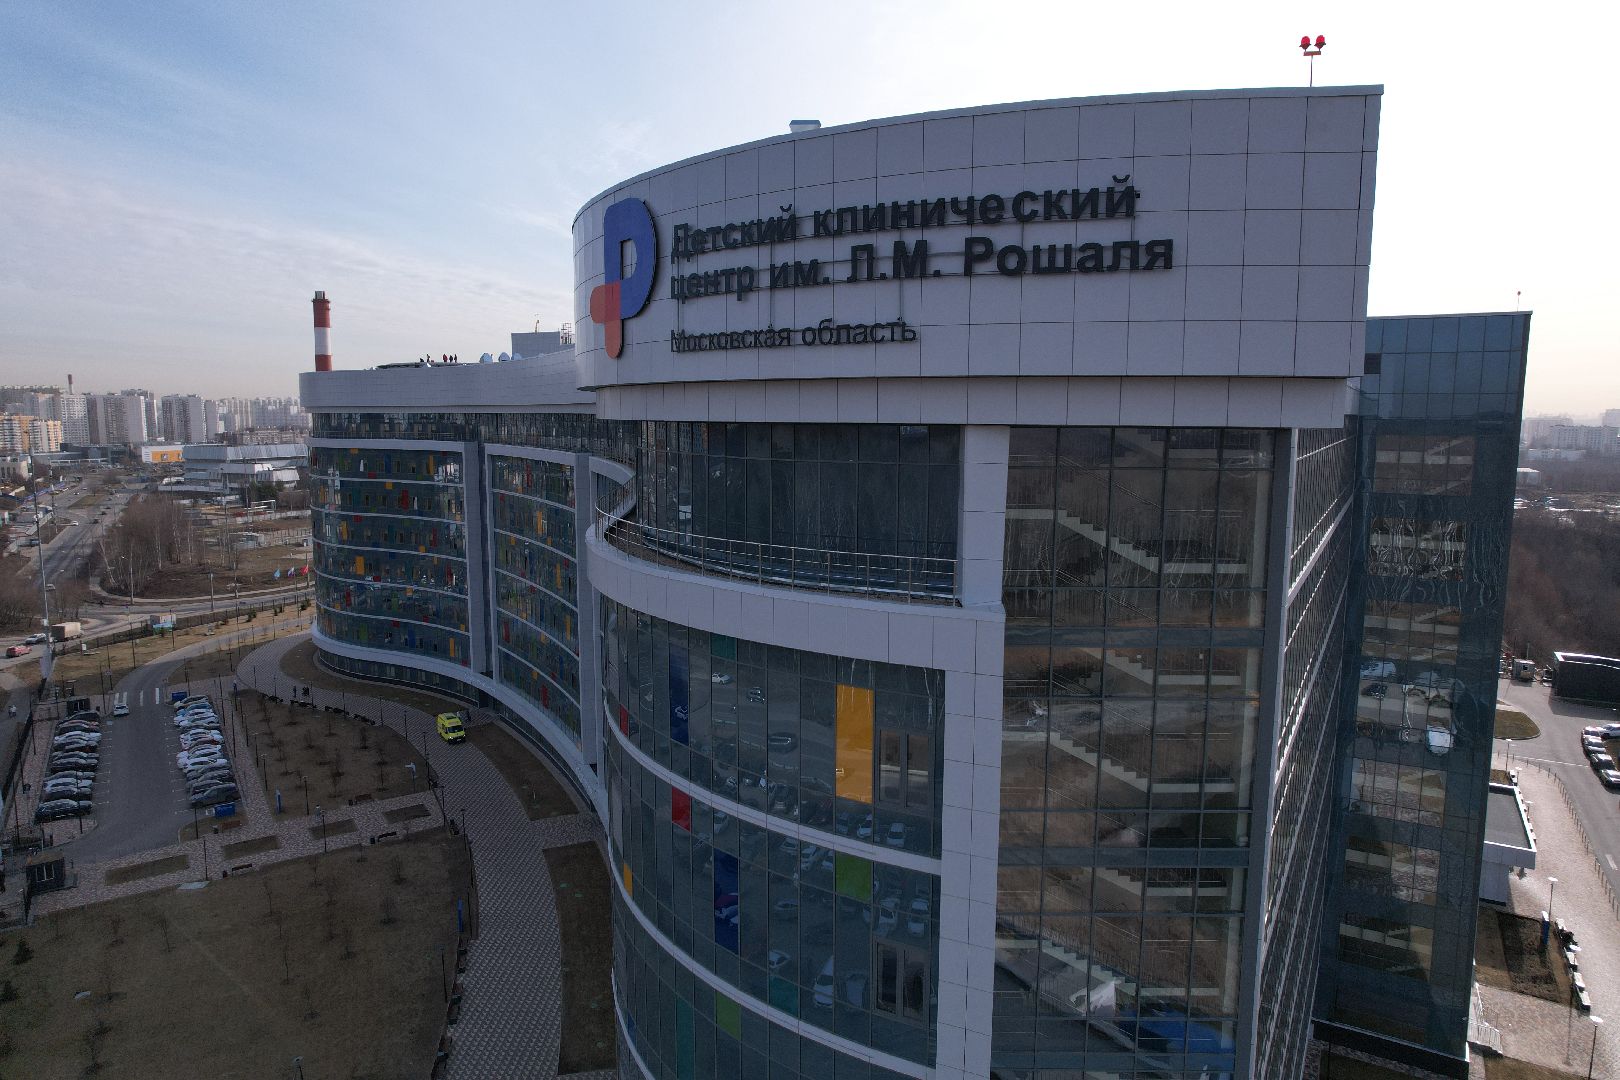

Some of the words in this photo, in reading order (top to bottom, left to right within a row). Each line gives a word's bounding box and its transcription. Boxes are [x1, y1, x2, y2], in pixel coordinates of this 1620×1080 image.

[670, 203, 797, 264] Детский
[813, 174, 1136, 238] клинический
[670, 265, 755, 304] центр
[769, 258, 830, 291] им.
[846, 239, 941, 284] Л.М.
[963, 236, 1174, 277] Рошаля
[670, 327, 791, 353] Московская
[801, 317, 917, 347] область
